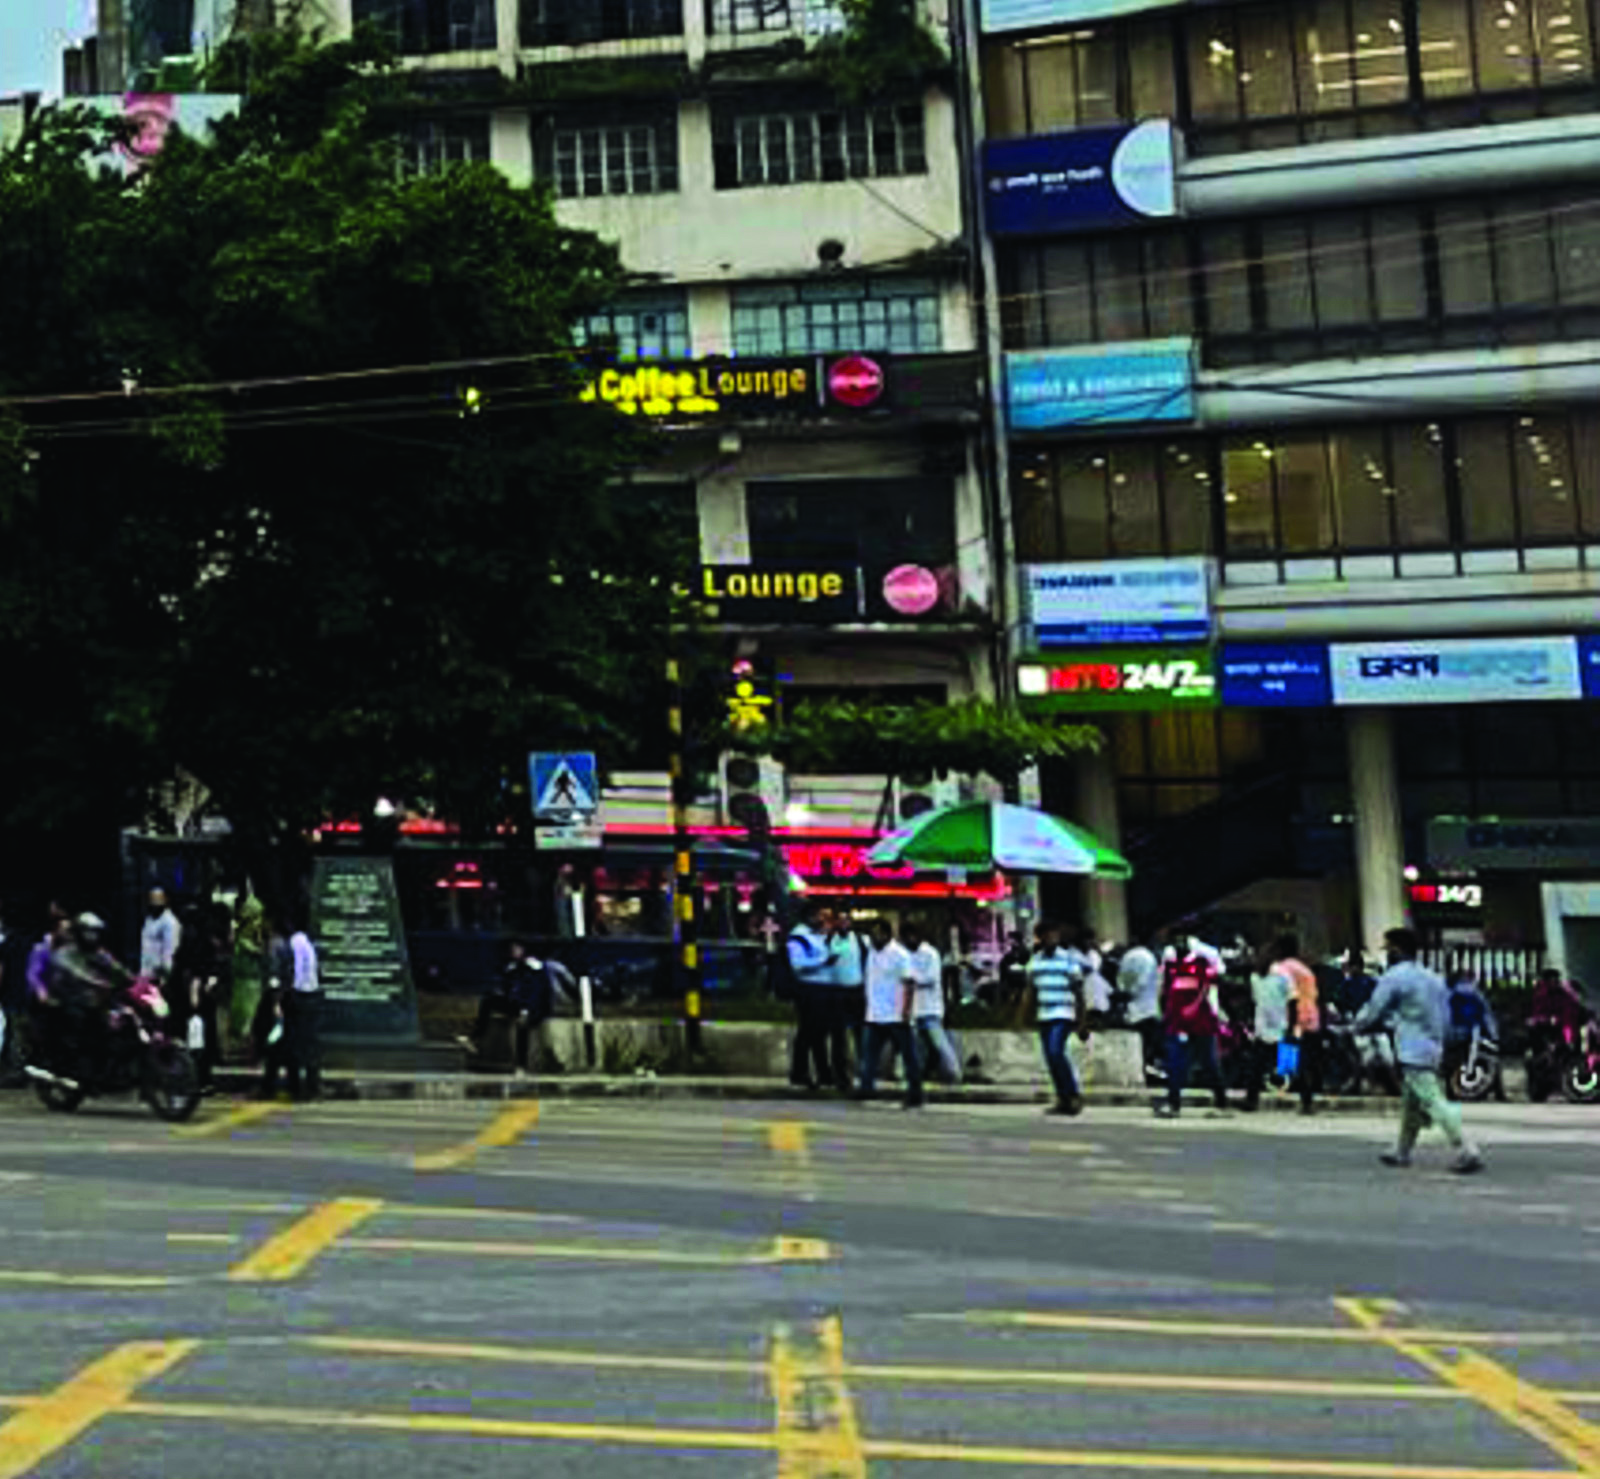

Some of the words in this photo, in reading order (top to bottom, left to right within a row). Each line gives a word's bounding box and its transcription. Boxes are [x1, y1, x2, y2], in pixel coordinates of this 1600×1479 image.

[600, 366, 697, 403] Coffee
[700, 366, 807, 400] Lounge
[703, 567, 844, 603] Lounge
